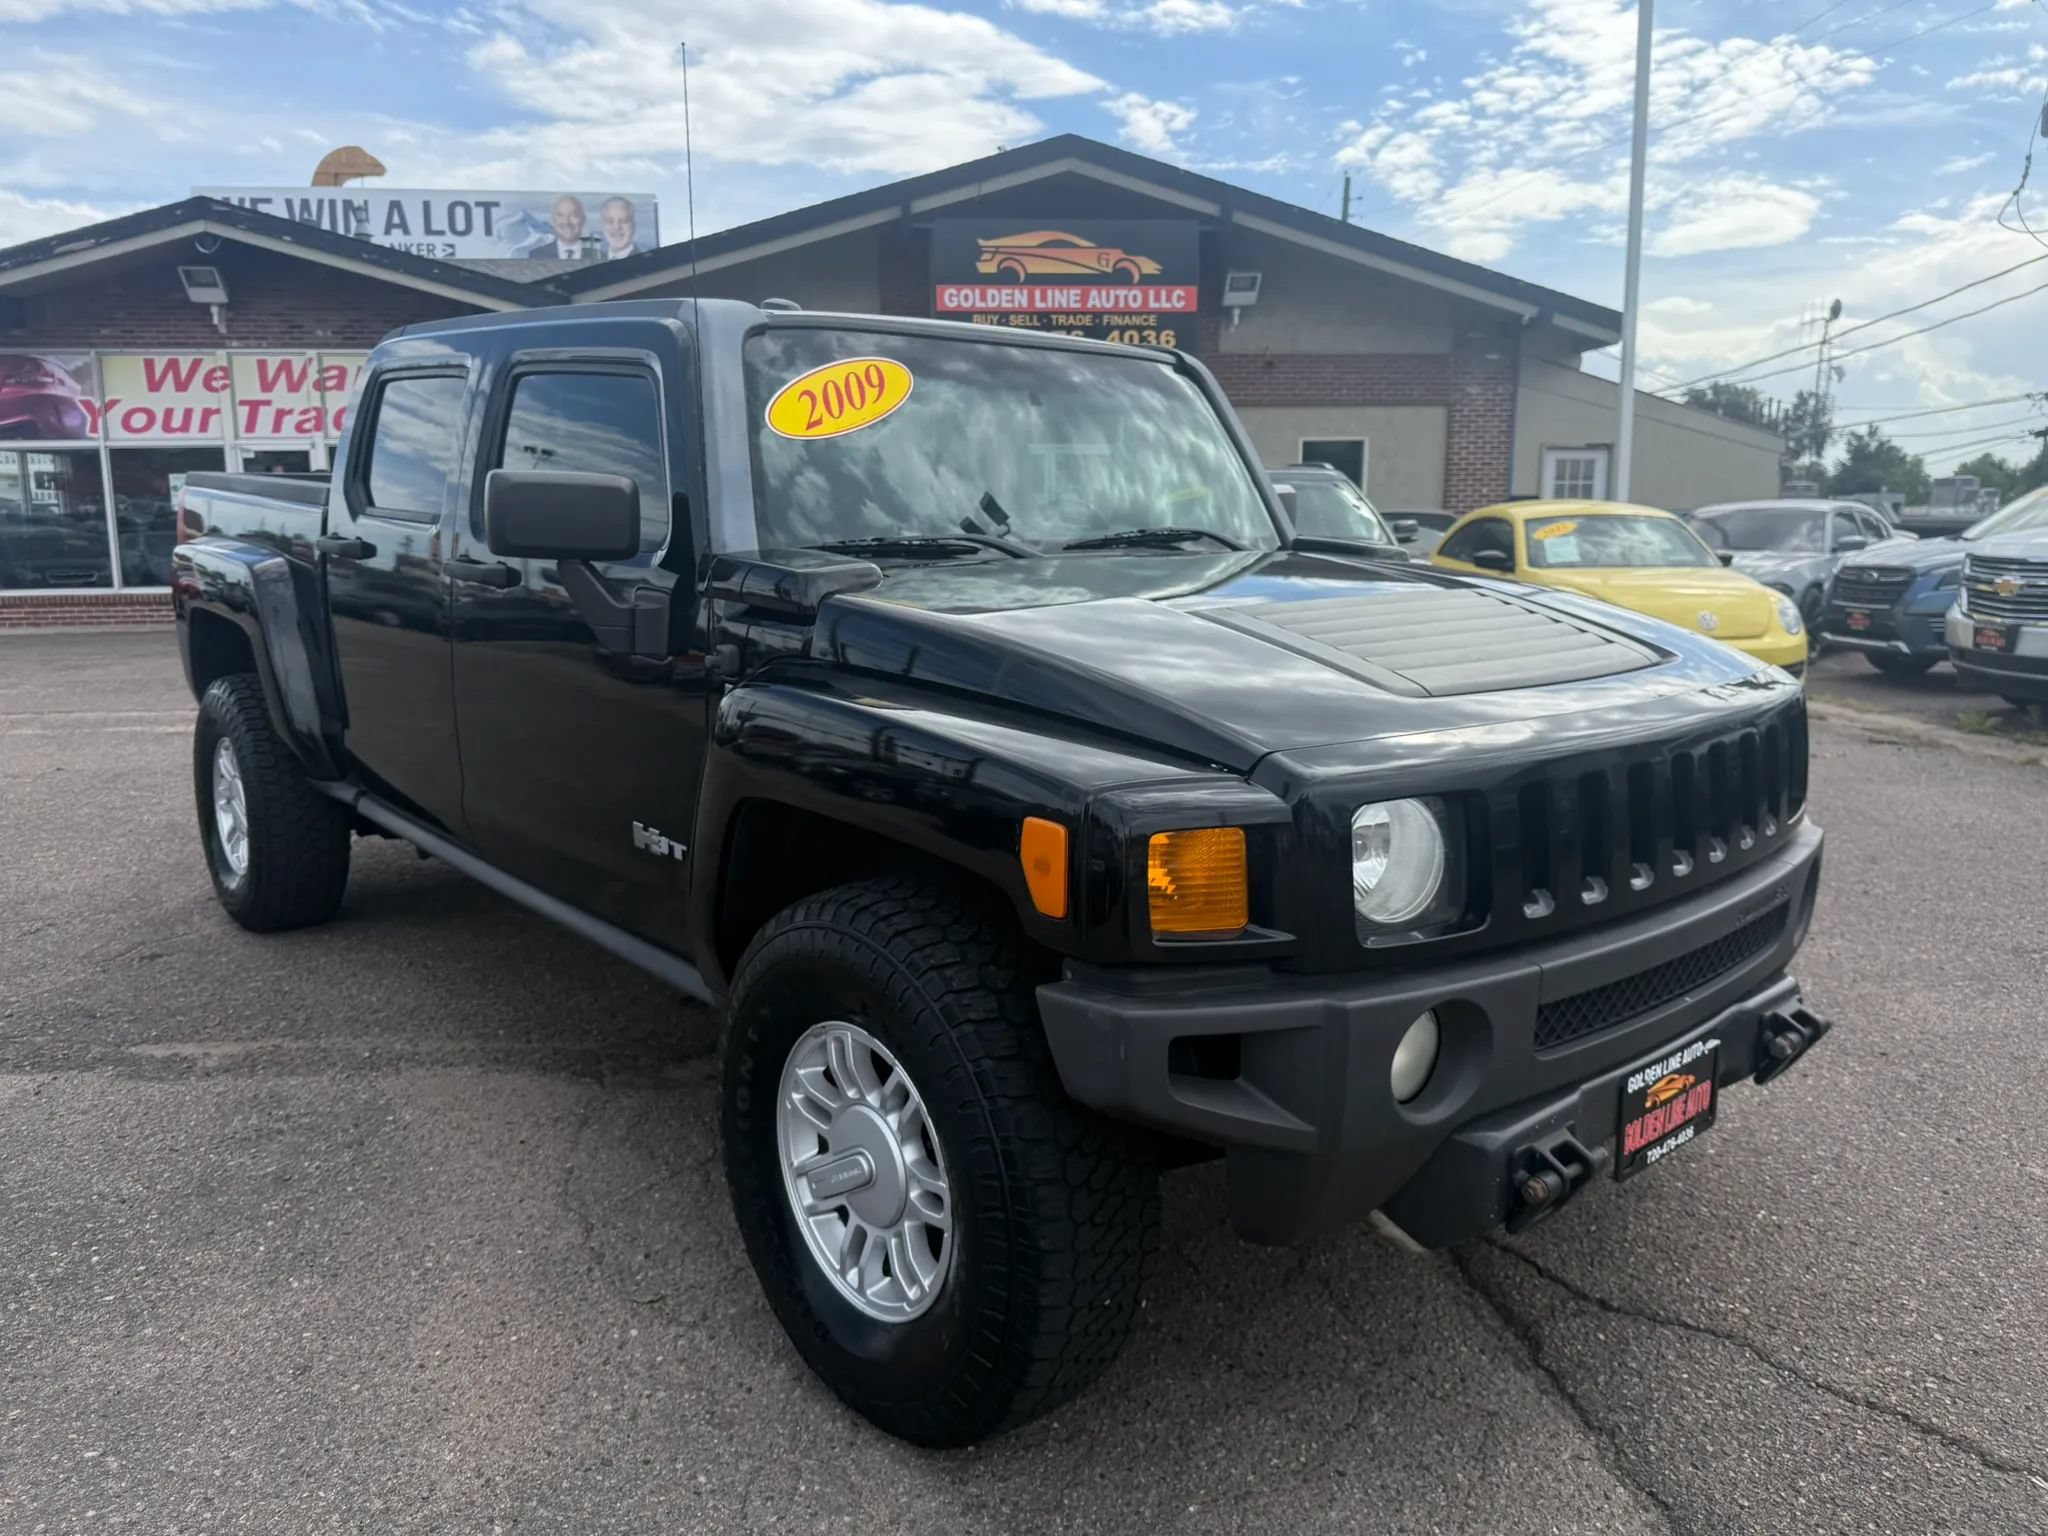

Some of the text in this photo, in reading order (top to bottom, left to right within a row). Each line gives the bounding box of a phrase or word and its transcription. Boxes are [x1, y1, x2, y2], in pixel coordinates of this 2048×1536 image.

[384, 200, 412, 236] A
[422, 200, 500, 237] LOT
[943, 288, 1186, 309] GOLDEN LINE AUTO LLC
[972, 314, 1158, 327] BUY SELL TRADE FINANCE
[142, 357, 362, 393] We Wa
[798, 363, 886, 431] 2009
[79, 398, 221, 435] Your
[1627, 1041, 1704, 1094] GOLDEN LINE AUTO
